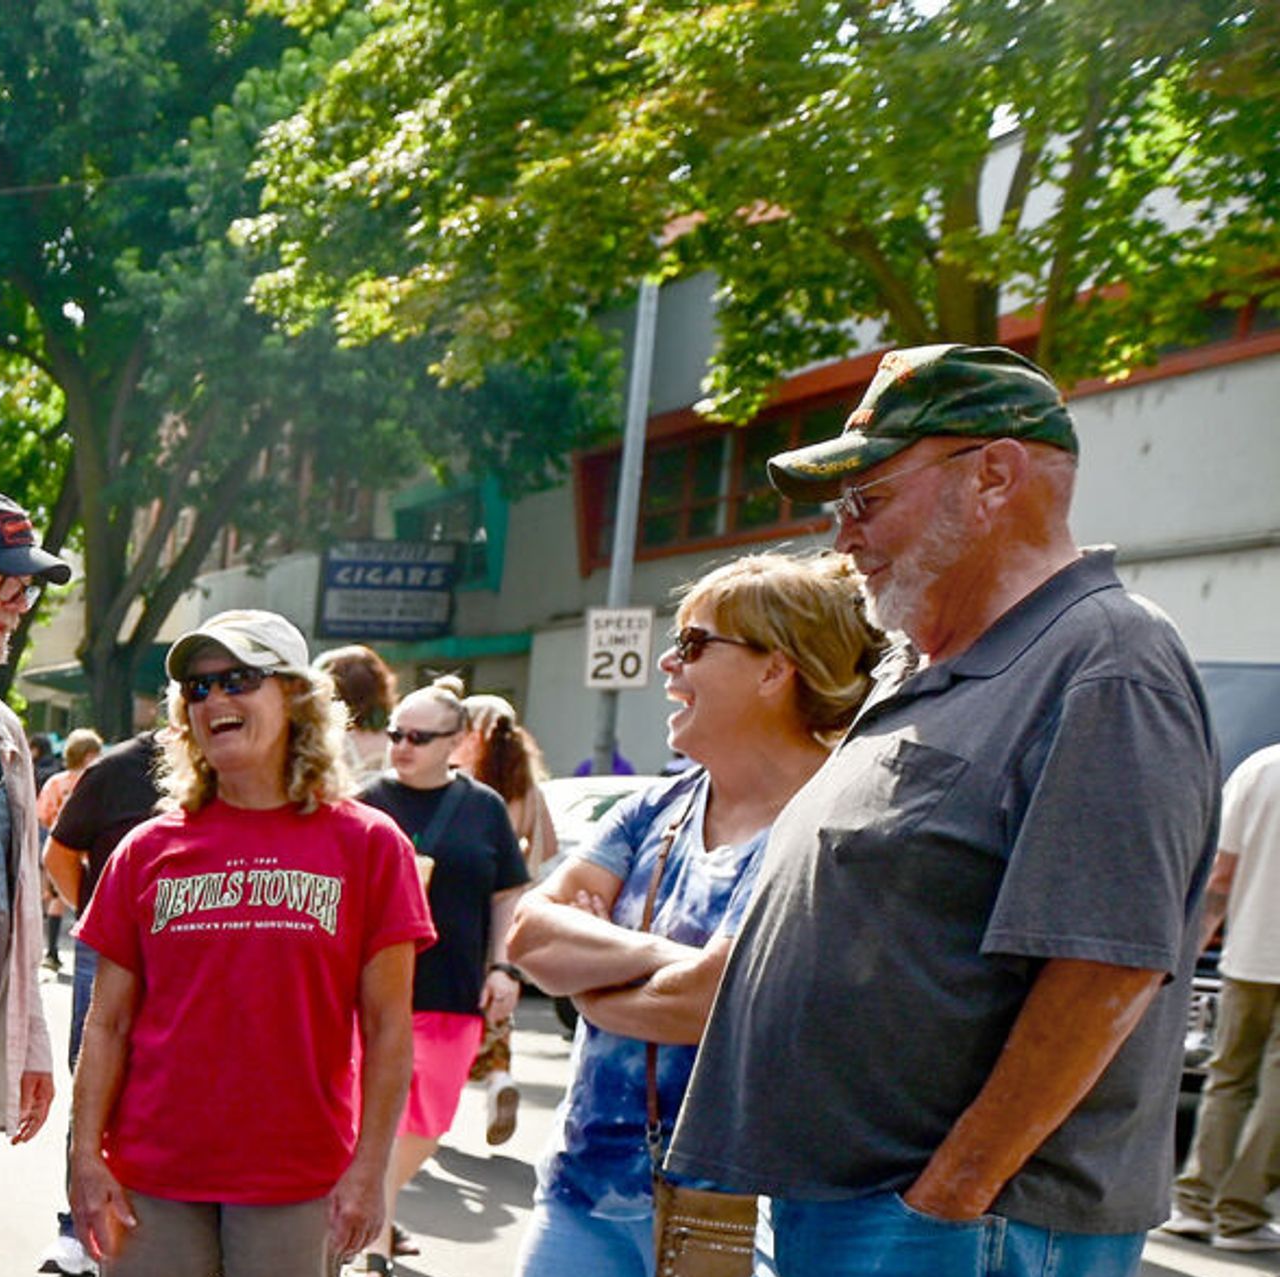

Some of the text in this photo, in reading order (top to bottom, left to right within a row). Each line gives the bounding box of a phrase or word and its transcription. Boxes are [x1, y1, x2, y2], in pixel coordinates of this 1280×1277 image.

[335, 565, 446, 586] CIGARS
[594, 617, 649, 631] SPEED
[597, 633, 640, 647] LIMIT
[591, 651, 642, 680] 20
[151, 868, 342, 936] DEVILS TOWER
[221, 920, 251, 931] FIRST
[254, 920, 315, 932] MONUMENT
